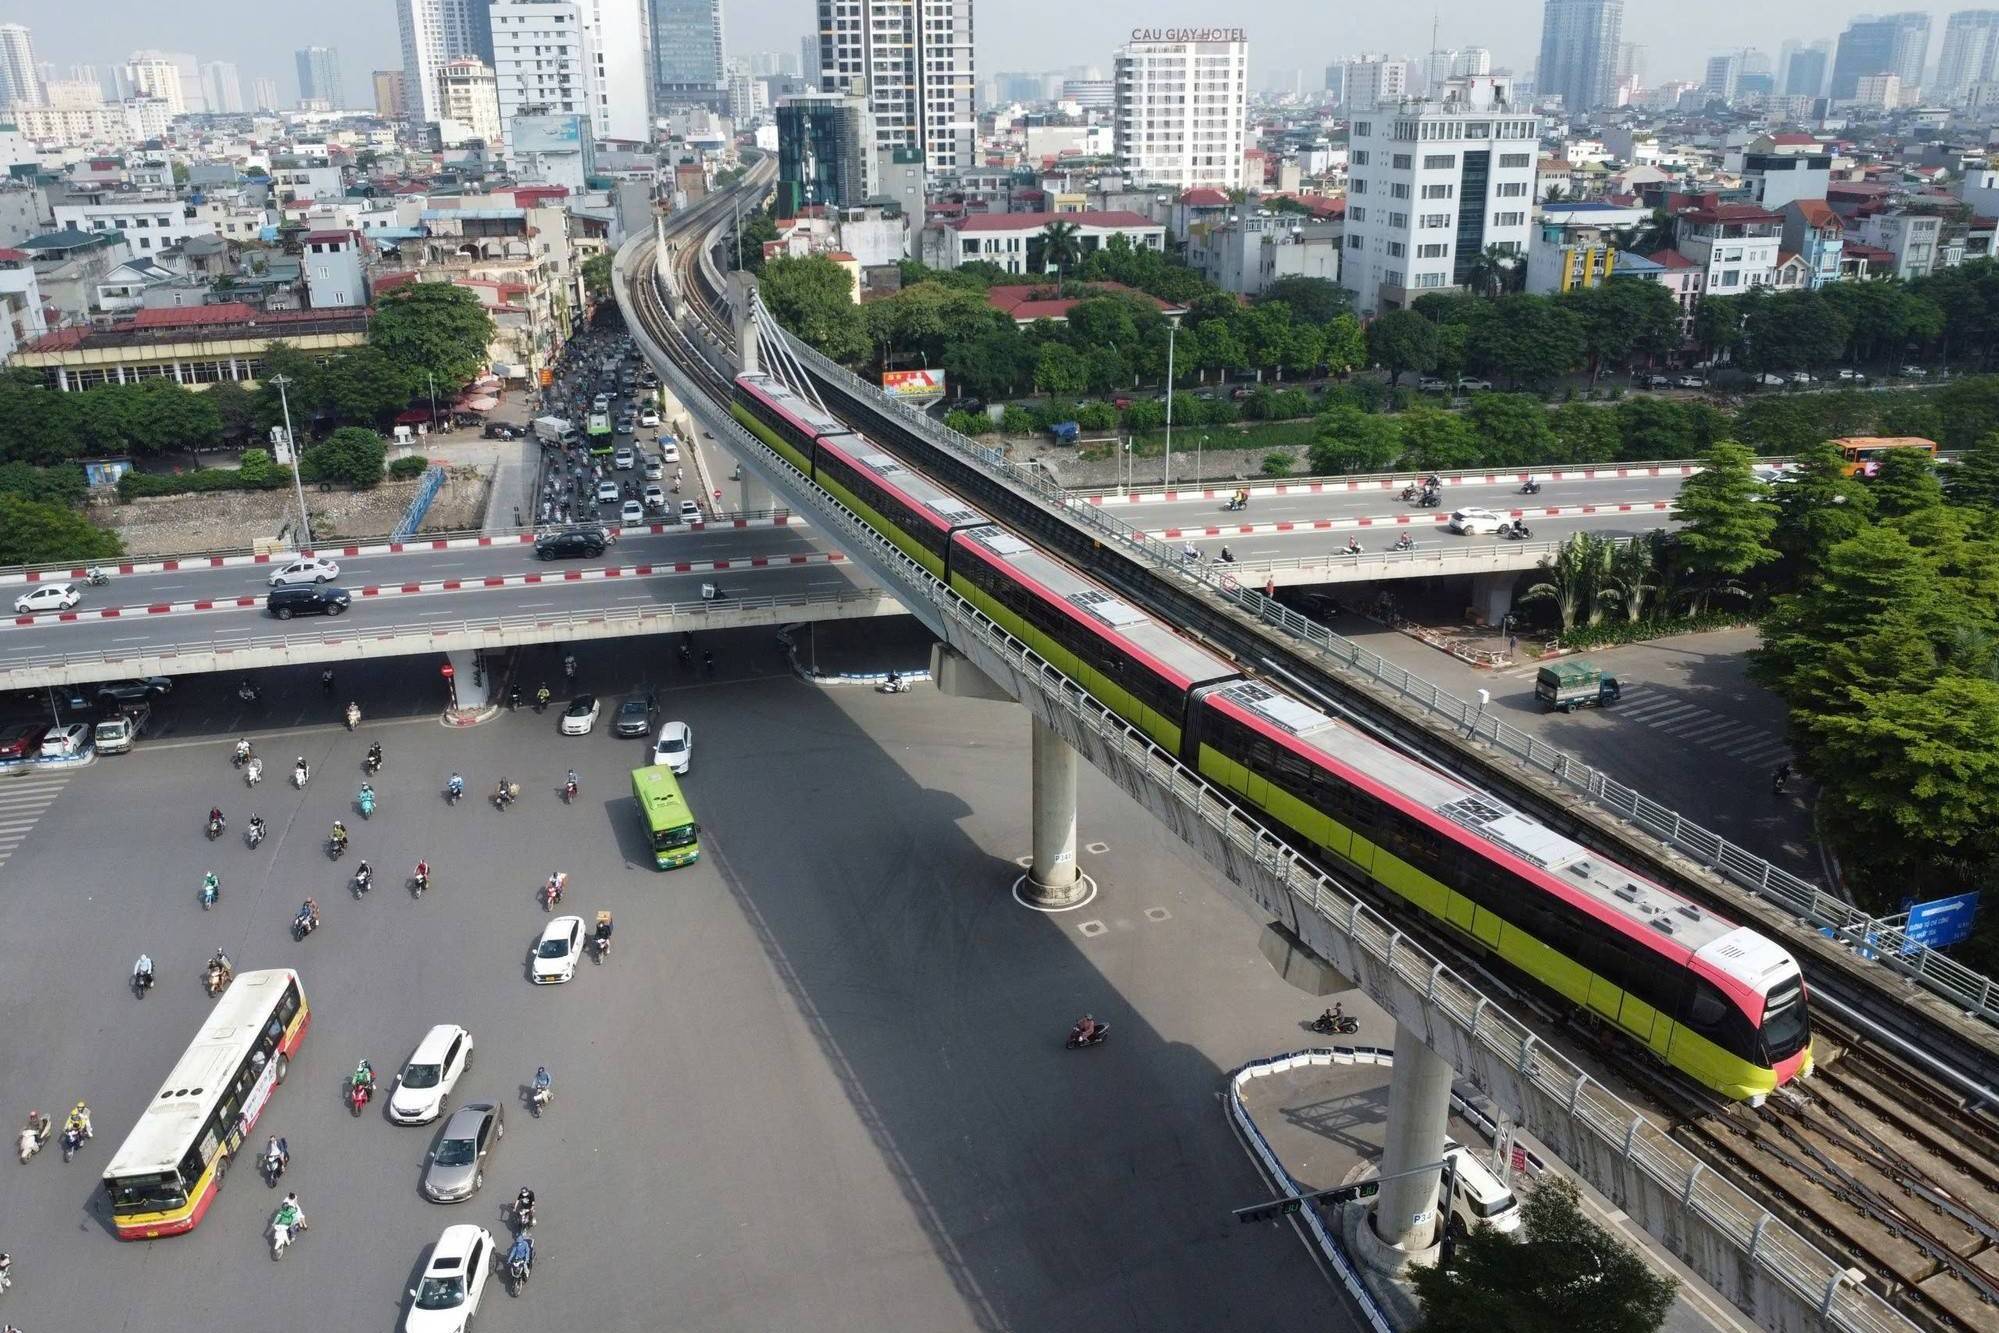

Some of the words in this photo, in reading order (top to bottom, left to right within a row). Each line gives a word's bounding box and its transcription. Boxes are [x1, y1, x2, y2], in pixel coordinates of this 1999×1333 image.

[1131, 28, 1162, 41] CAU
[1165, 28, 1198, 41] GIAY
[1201, 28, 1248, 41] HOTEL
